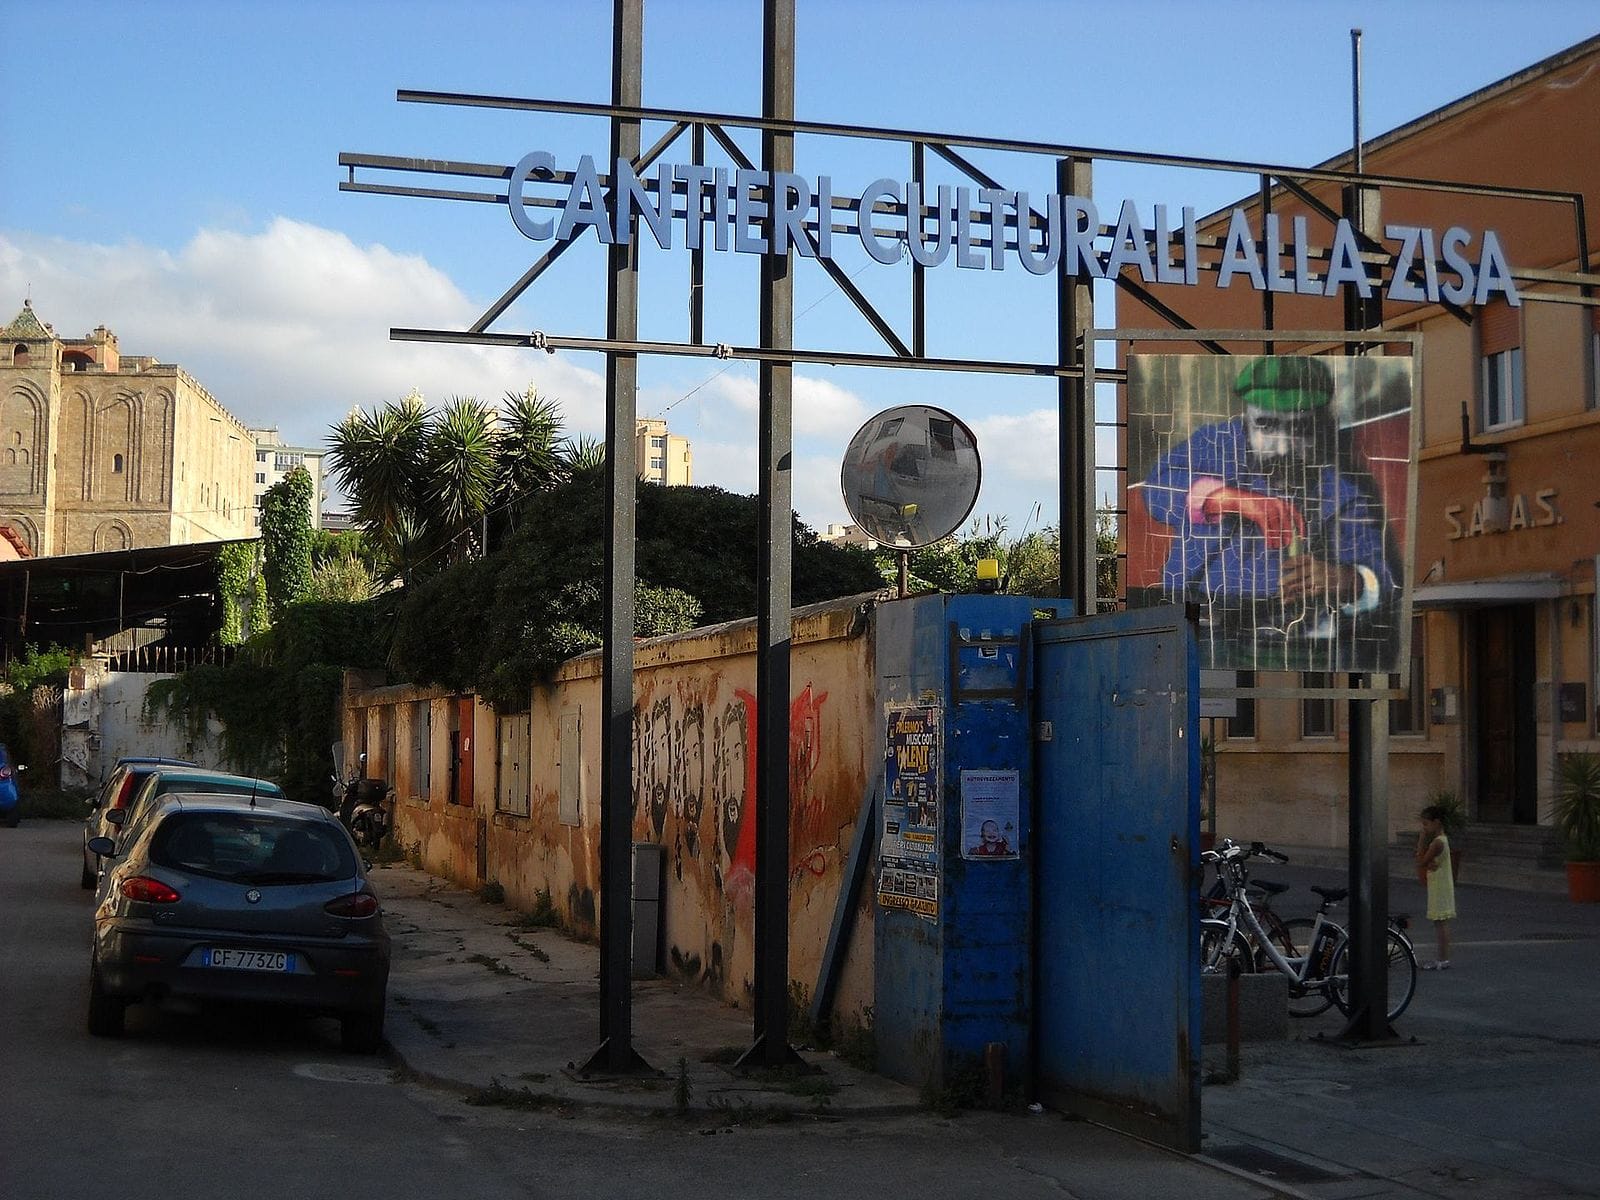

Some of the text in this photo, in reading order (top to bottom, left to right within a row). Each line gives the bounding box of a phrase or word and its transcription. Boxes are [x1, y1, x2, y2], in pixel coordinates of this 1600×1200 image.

[508, 151, 1522, 307] CANTIERI CULTURALI ALLA ZISA
[896, 745, 929, 770] TALENT
